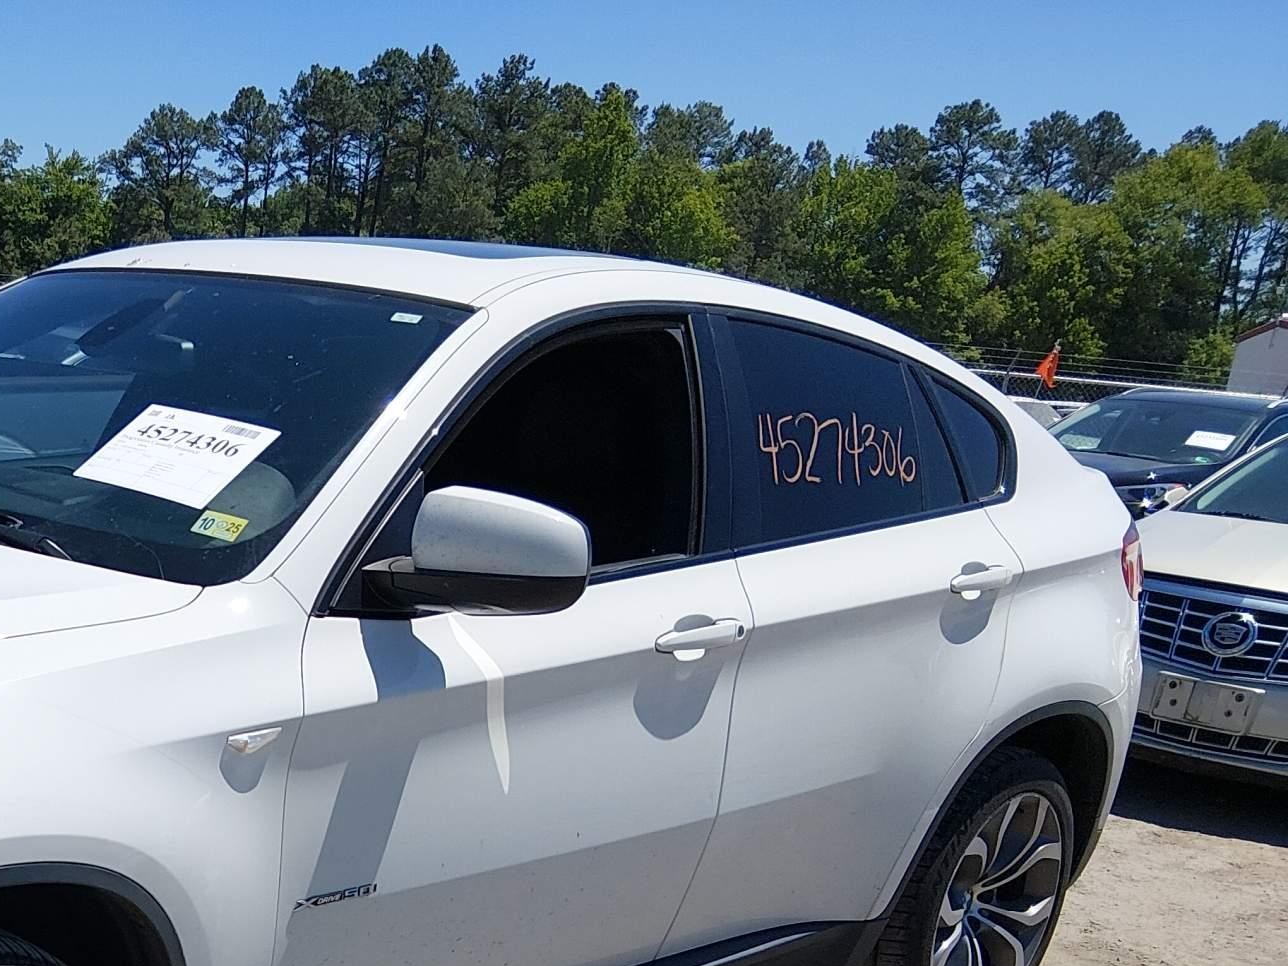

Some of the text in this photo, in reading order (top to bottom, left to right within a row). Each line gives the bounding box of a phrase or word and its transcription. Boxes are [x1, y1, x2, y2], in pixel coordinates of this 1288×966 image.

[137, 423, 247, 458] 45274306
[757, 411, 916, 487] 45274306
[198, 516, 243, 534] 10 25
